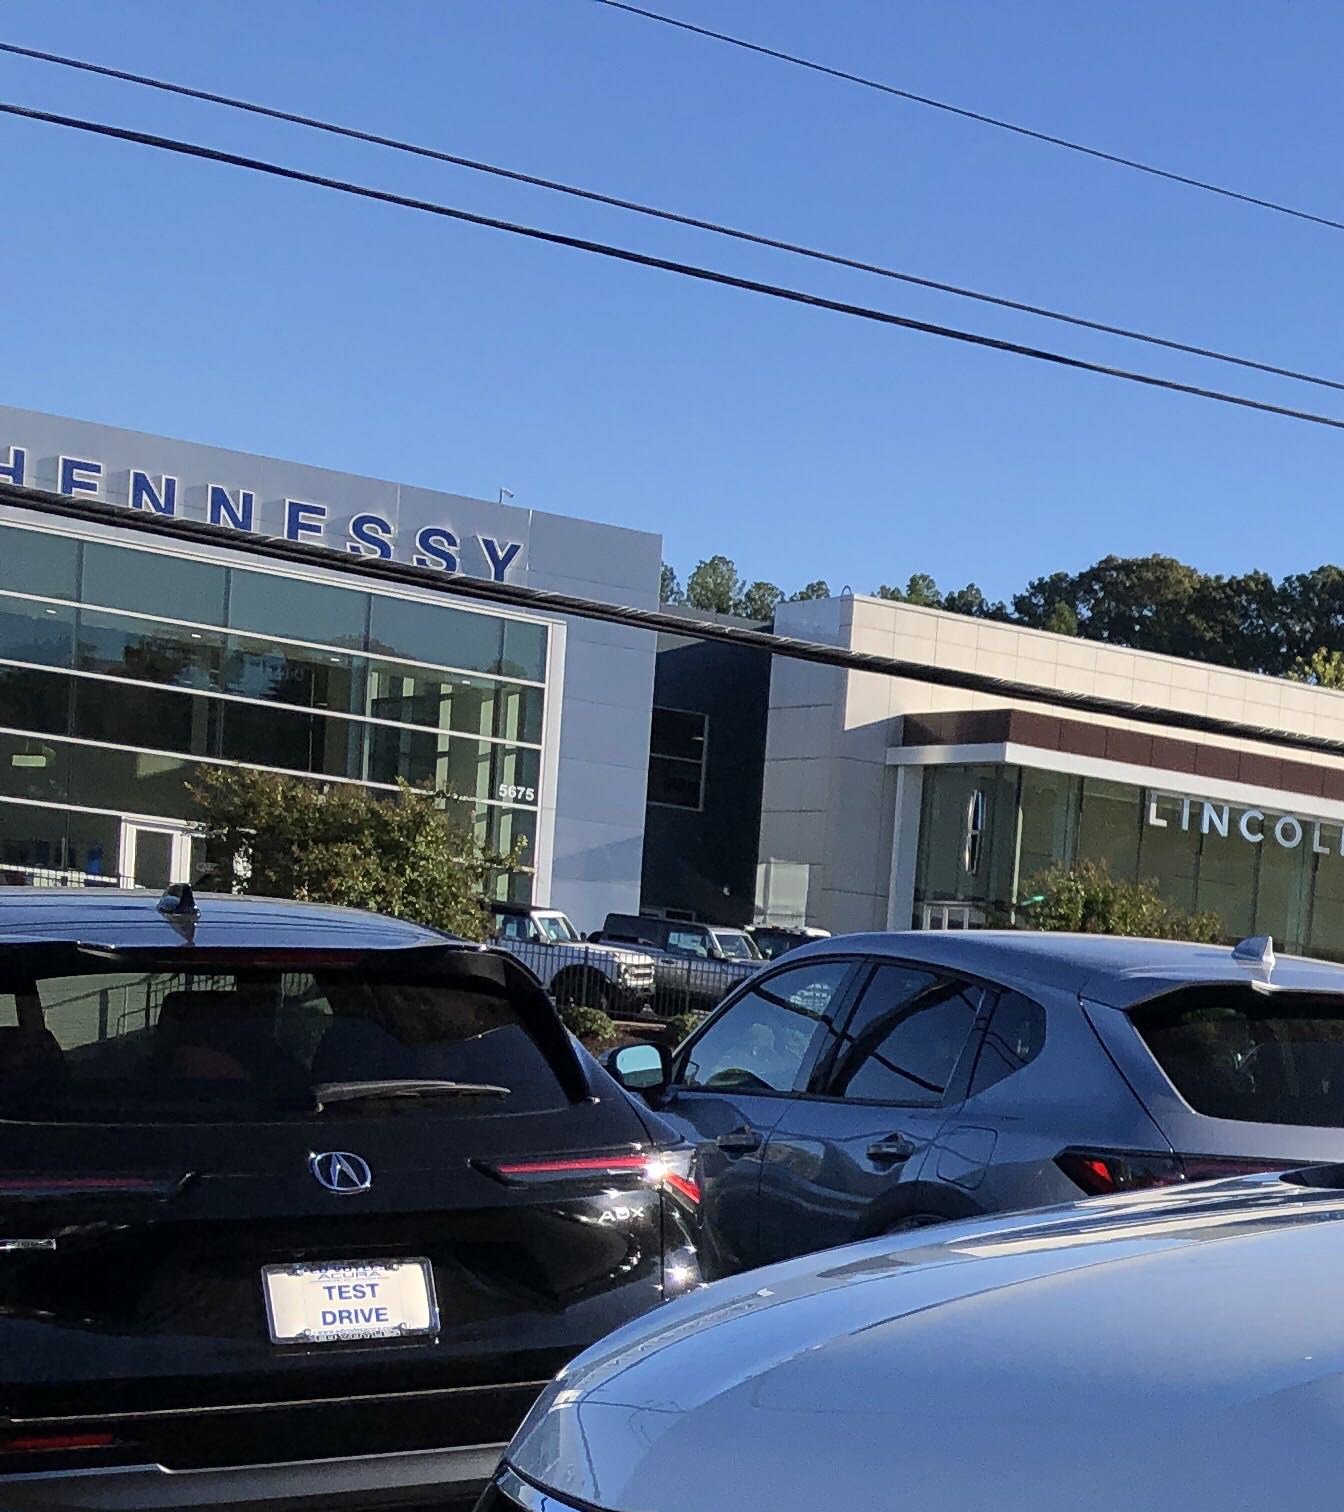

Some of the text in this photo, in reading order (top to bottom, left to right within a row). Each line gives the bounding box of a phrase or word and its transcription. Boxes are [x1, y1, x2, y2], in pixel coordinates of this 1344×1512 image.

[0, 446, 524, 582] HENNESSY
[498, 783, 535, 802] 5675
[597, 1206, 645, 1224] ADX
[322, 1283, 379, 1301] TEST
[321, 1306, 389, 1326] DRIVE
